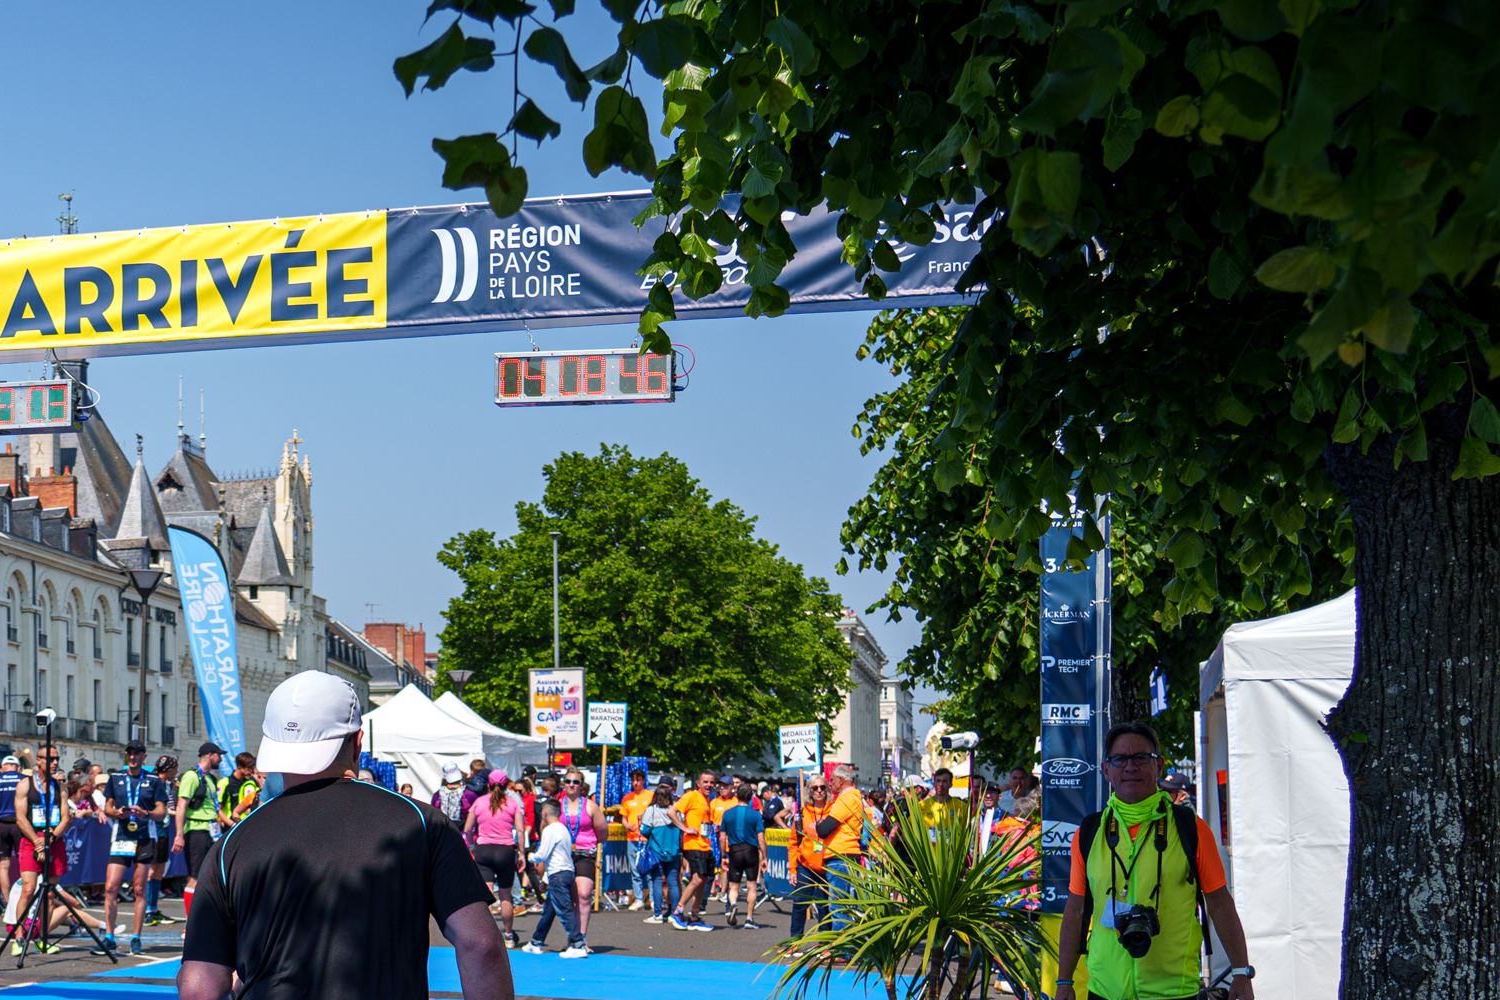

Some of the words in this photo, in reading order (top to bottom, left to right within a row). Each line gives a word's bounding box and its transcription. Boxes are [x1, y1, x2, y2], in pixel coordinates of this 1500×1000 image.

[489, 223, 581, 249] RÉGION
[489, 250, 551, 275] PAYS
[0, 229, 375, 338] ARRIVÉE
[490, 277, 505, 288] DE
[512, 273, 581, 299] LOIRE
[490, 289, 505, 300] LA
[1045, 558, 1057, 573] 3
[1041, 608, 1090, 618] ACKERMAN
[537, 686, 564, 696] HAN
[564, 701, 576, 710] DI
[590, 706, 625, 714] MÉDAILLES
[537, 712, 563, 722] CAP
[1050, 706, 1080, 718] RMC
[781, 729, 816, 738] MÉDAILLES
[1049, 761, 1080, 773] Ford
[1043, 831, 1075, 844] SNC
[1046, 886, 1057, 901] 3
